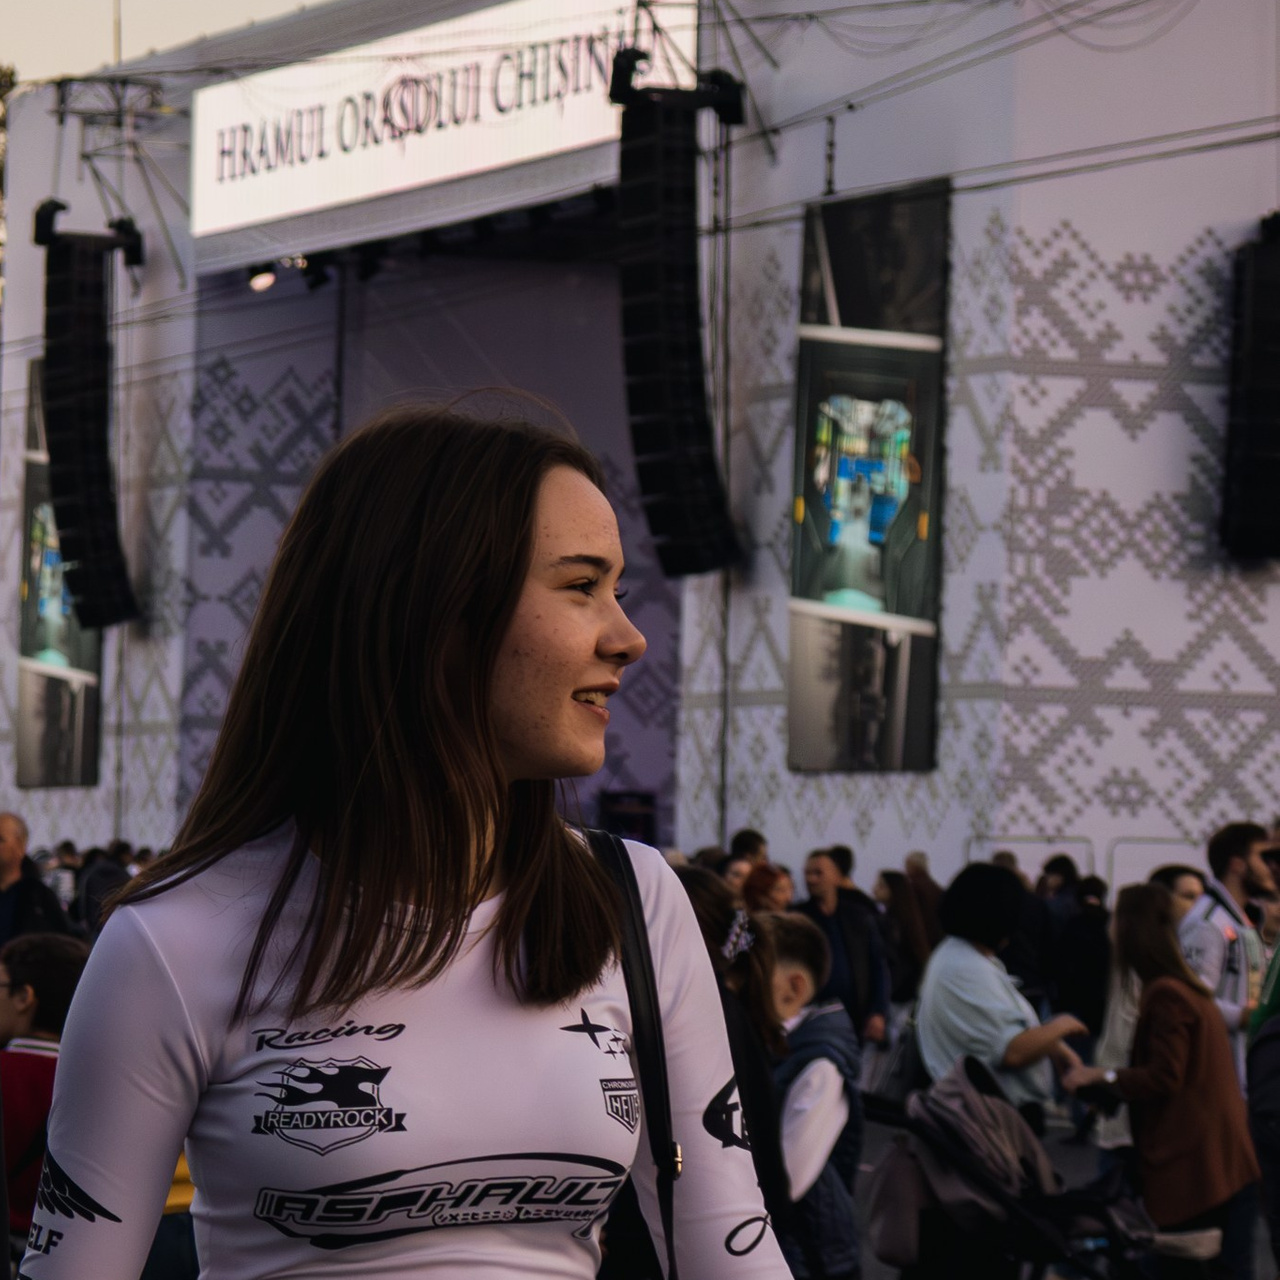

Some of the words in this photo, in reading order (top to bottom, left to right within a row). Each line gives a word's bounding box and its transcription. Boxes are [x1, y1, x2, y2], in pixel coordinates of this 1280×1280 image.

[216, 104, 329, 183] HRAMUL
[252, 1020, 406, 1052] Racing
[267, 1108, 389, 1129] READYROCK
